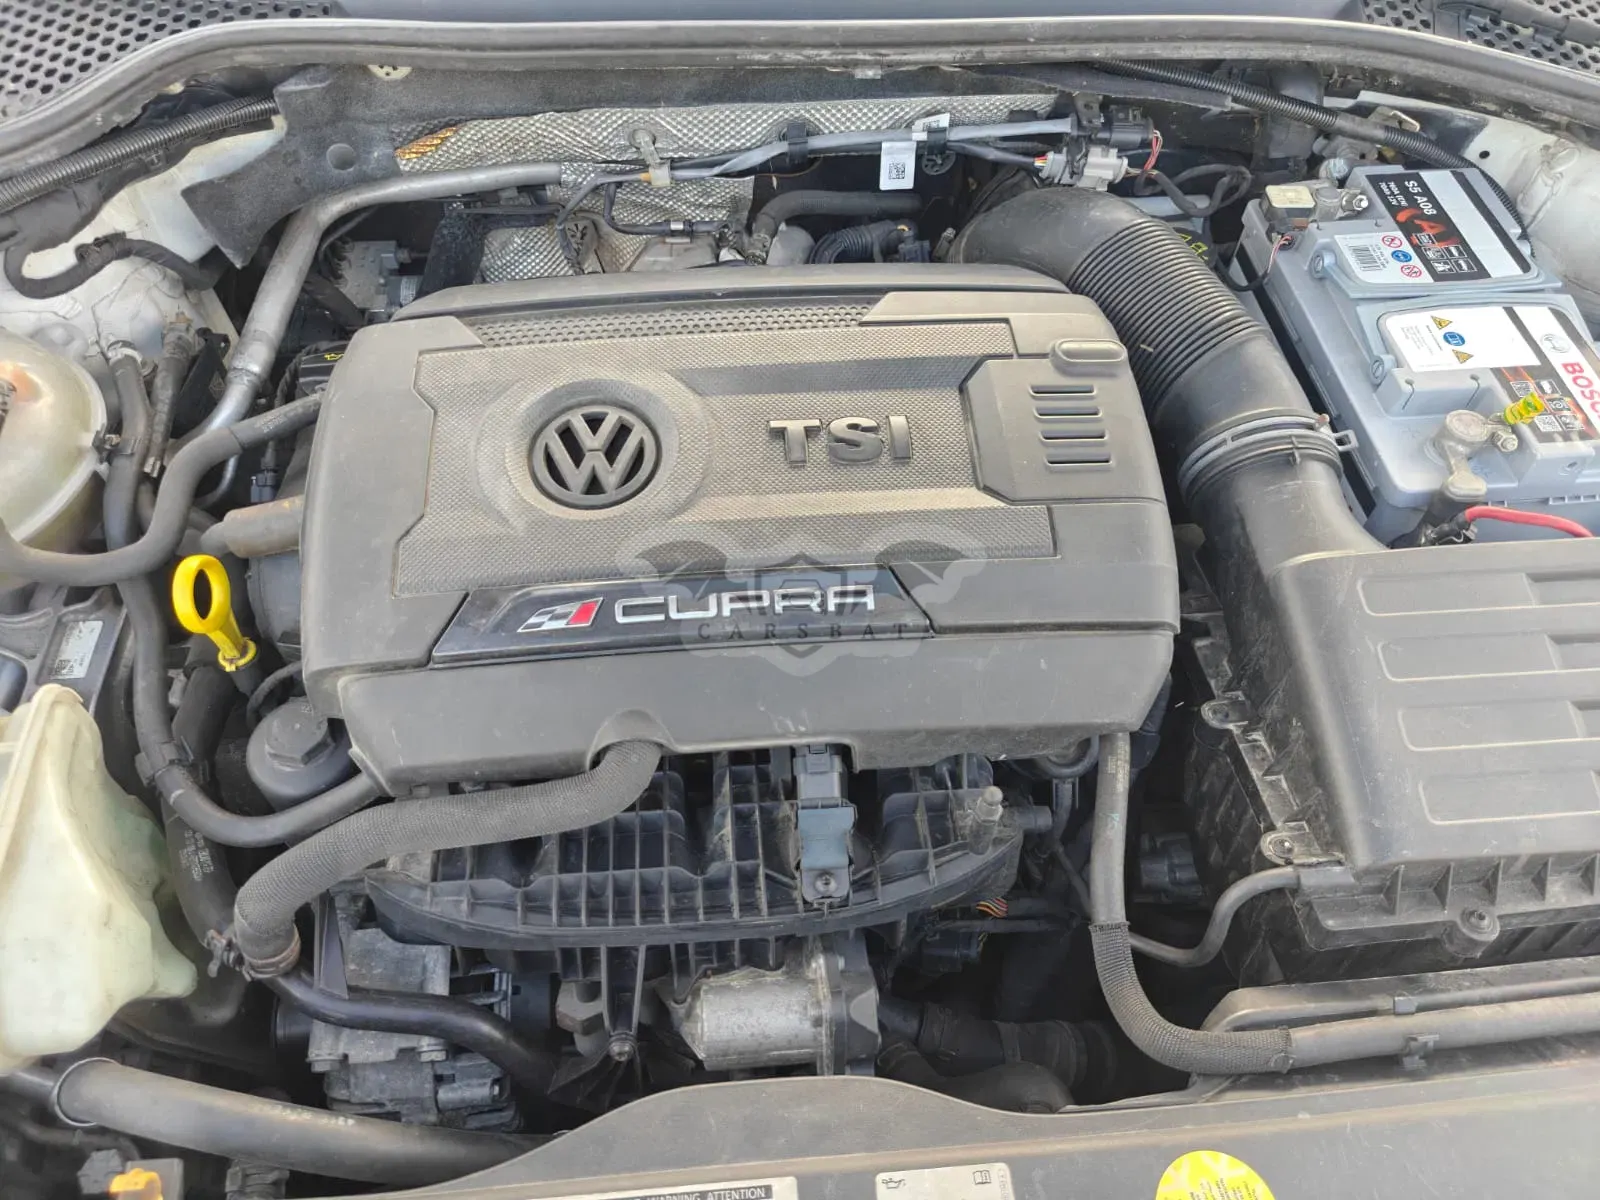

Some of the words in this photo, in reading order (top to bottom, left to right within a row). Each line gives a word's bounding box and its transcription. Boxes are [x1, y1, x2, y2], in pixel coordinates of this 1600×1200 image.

[1404, 180, 1422, 193] S5
[1413, 195, 1438, 215] A08
[767, 415, 912, 465] TSI
[614, 584, 876, 624] CUPRA
[706, 1187, 767, 1200] ATTENTION
